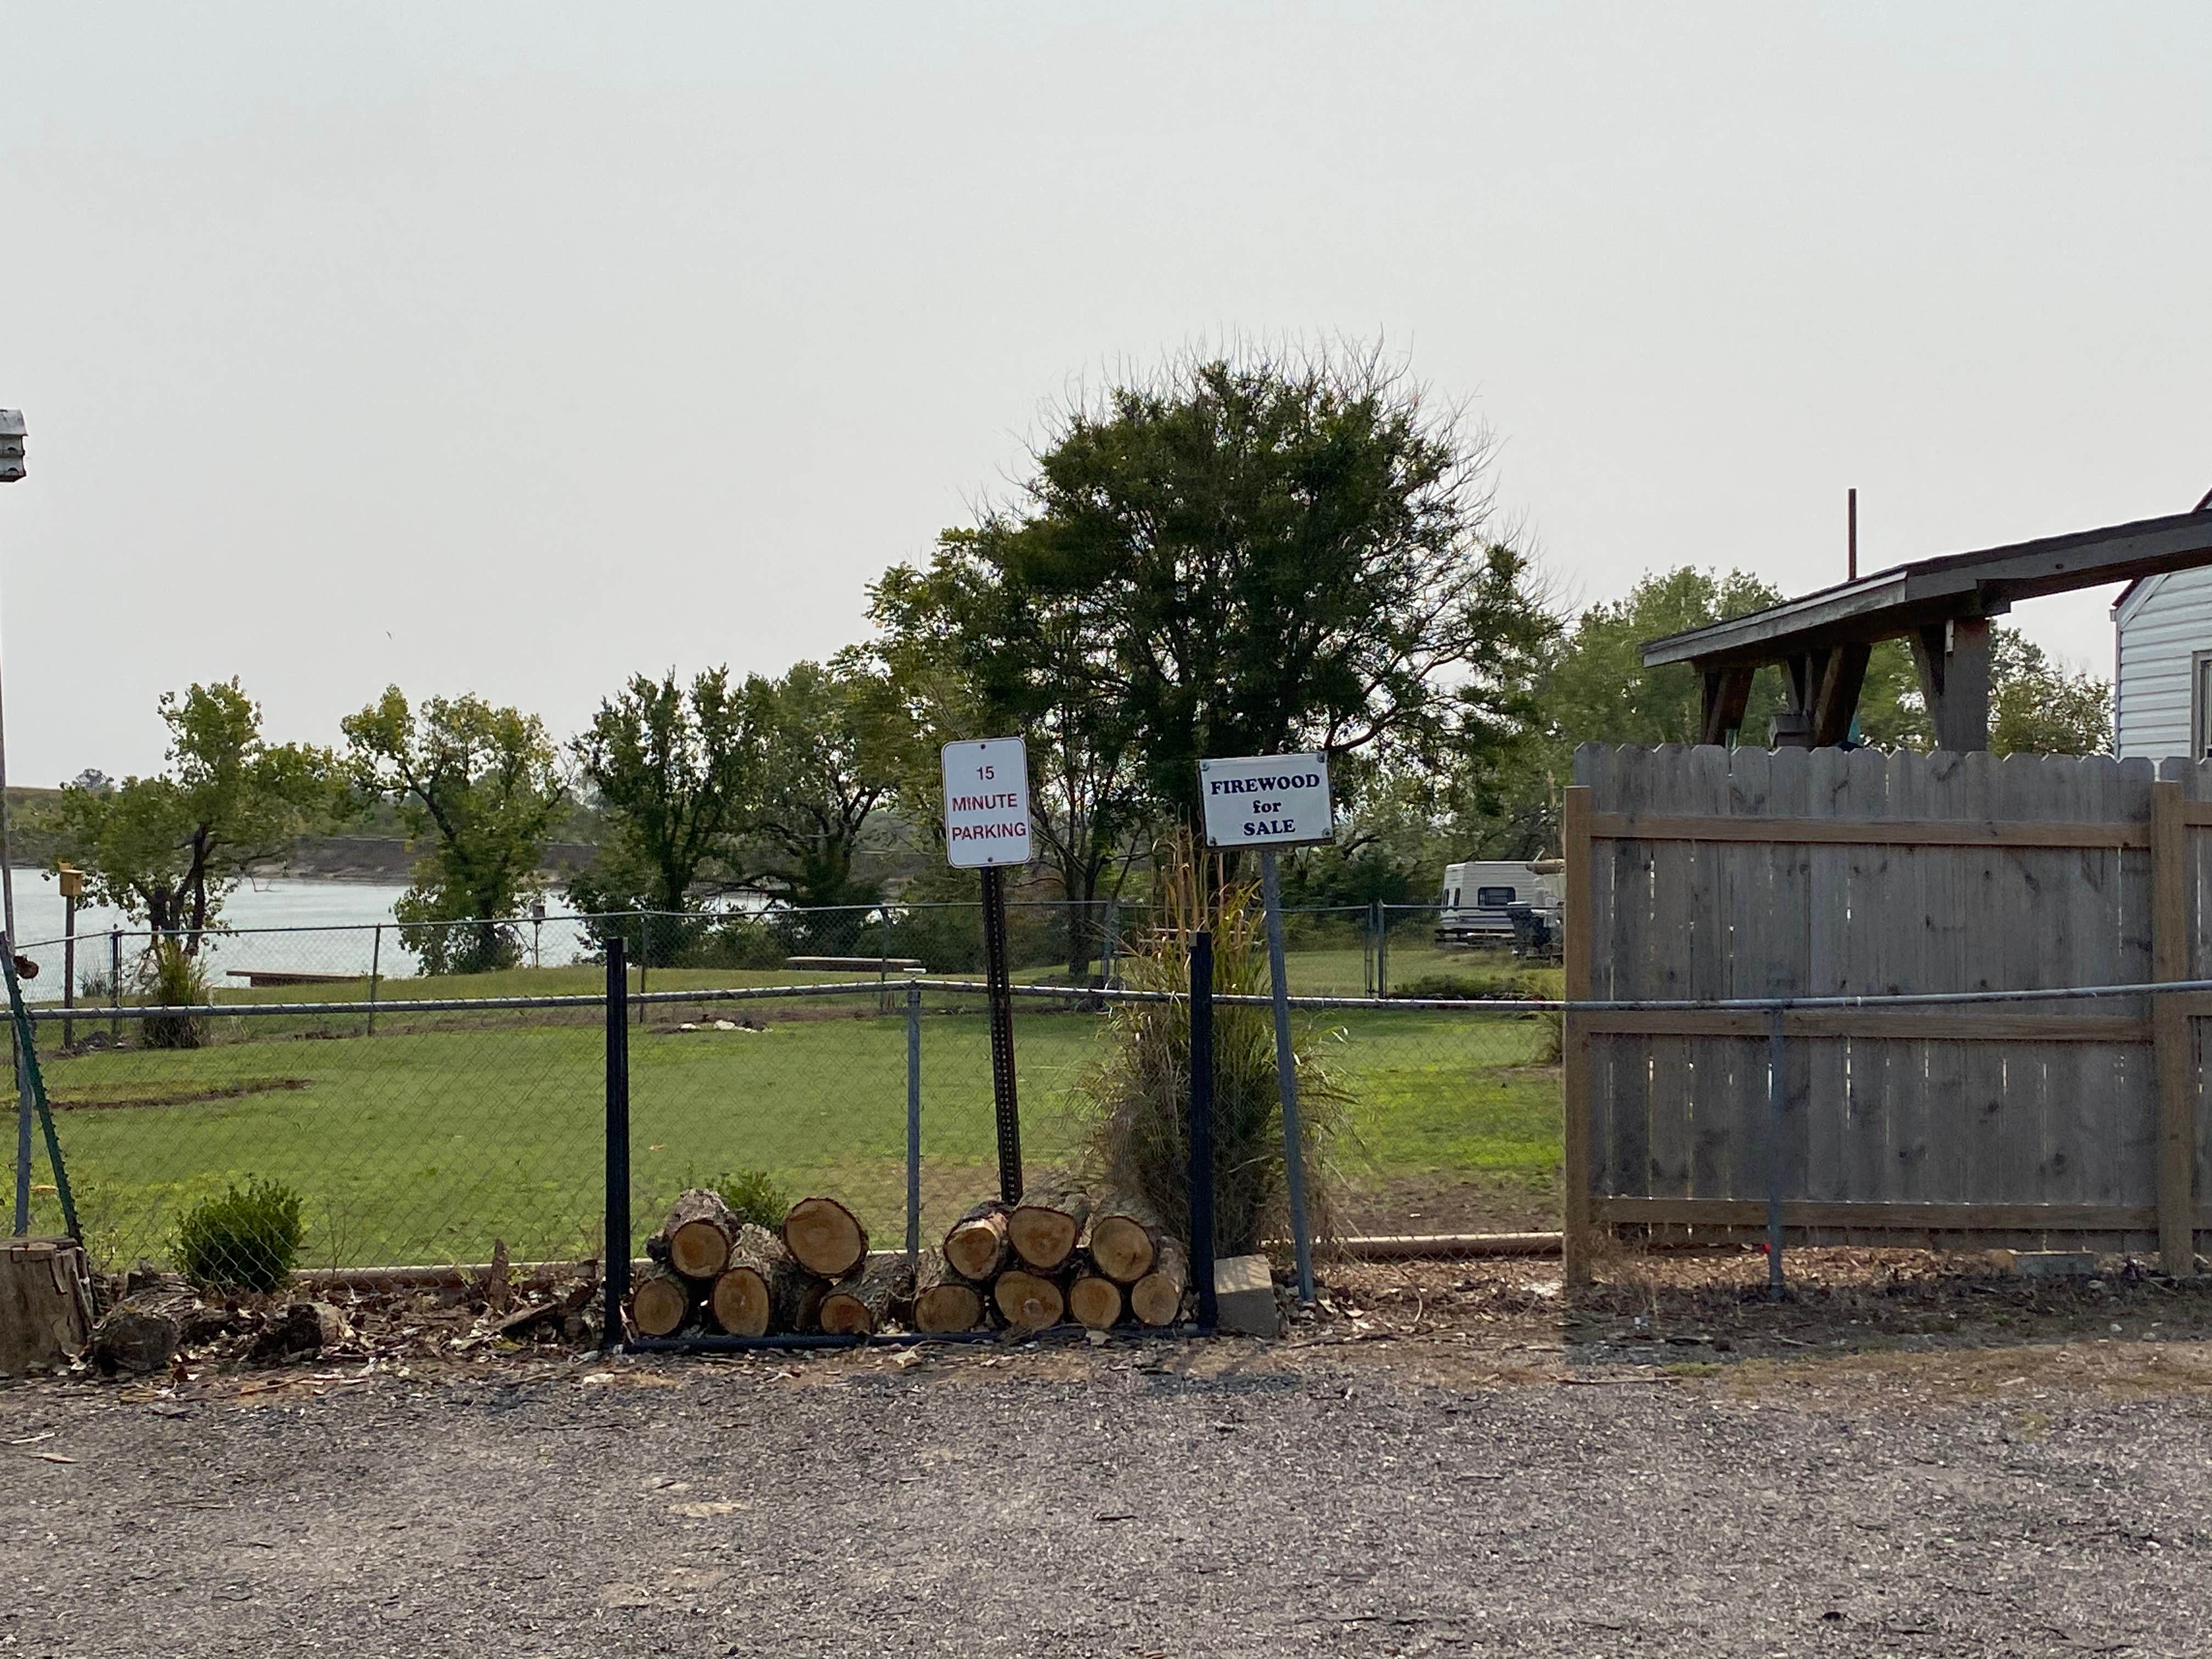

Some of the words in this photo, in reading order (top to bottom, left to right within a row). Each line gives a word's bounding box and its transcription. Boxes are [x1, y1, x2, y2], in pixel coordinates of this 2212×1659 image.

[977, 766, 994, 780] 15
[1211, 774, 1319, 795] FIREWOOD
[952, 793, 1018, 811] MINUTE
[1252, 800, 1281, 814] for
[952, 822, 1026, 841] PARKING
[1244, 819, 1296, 836] SALE
